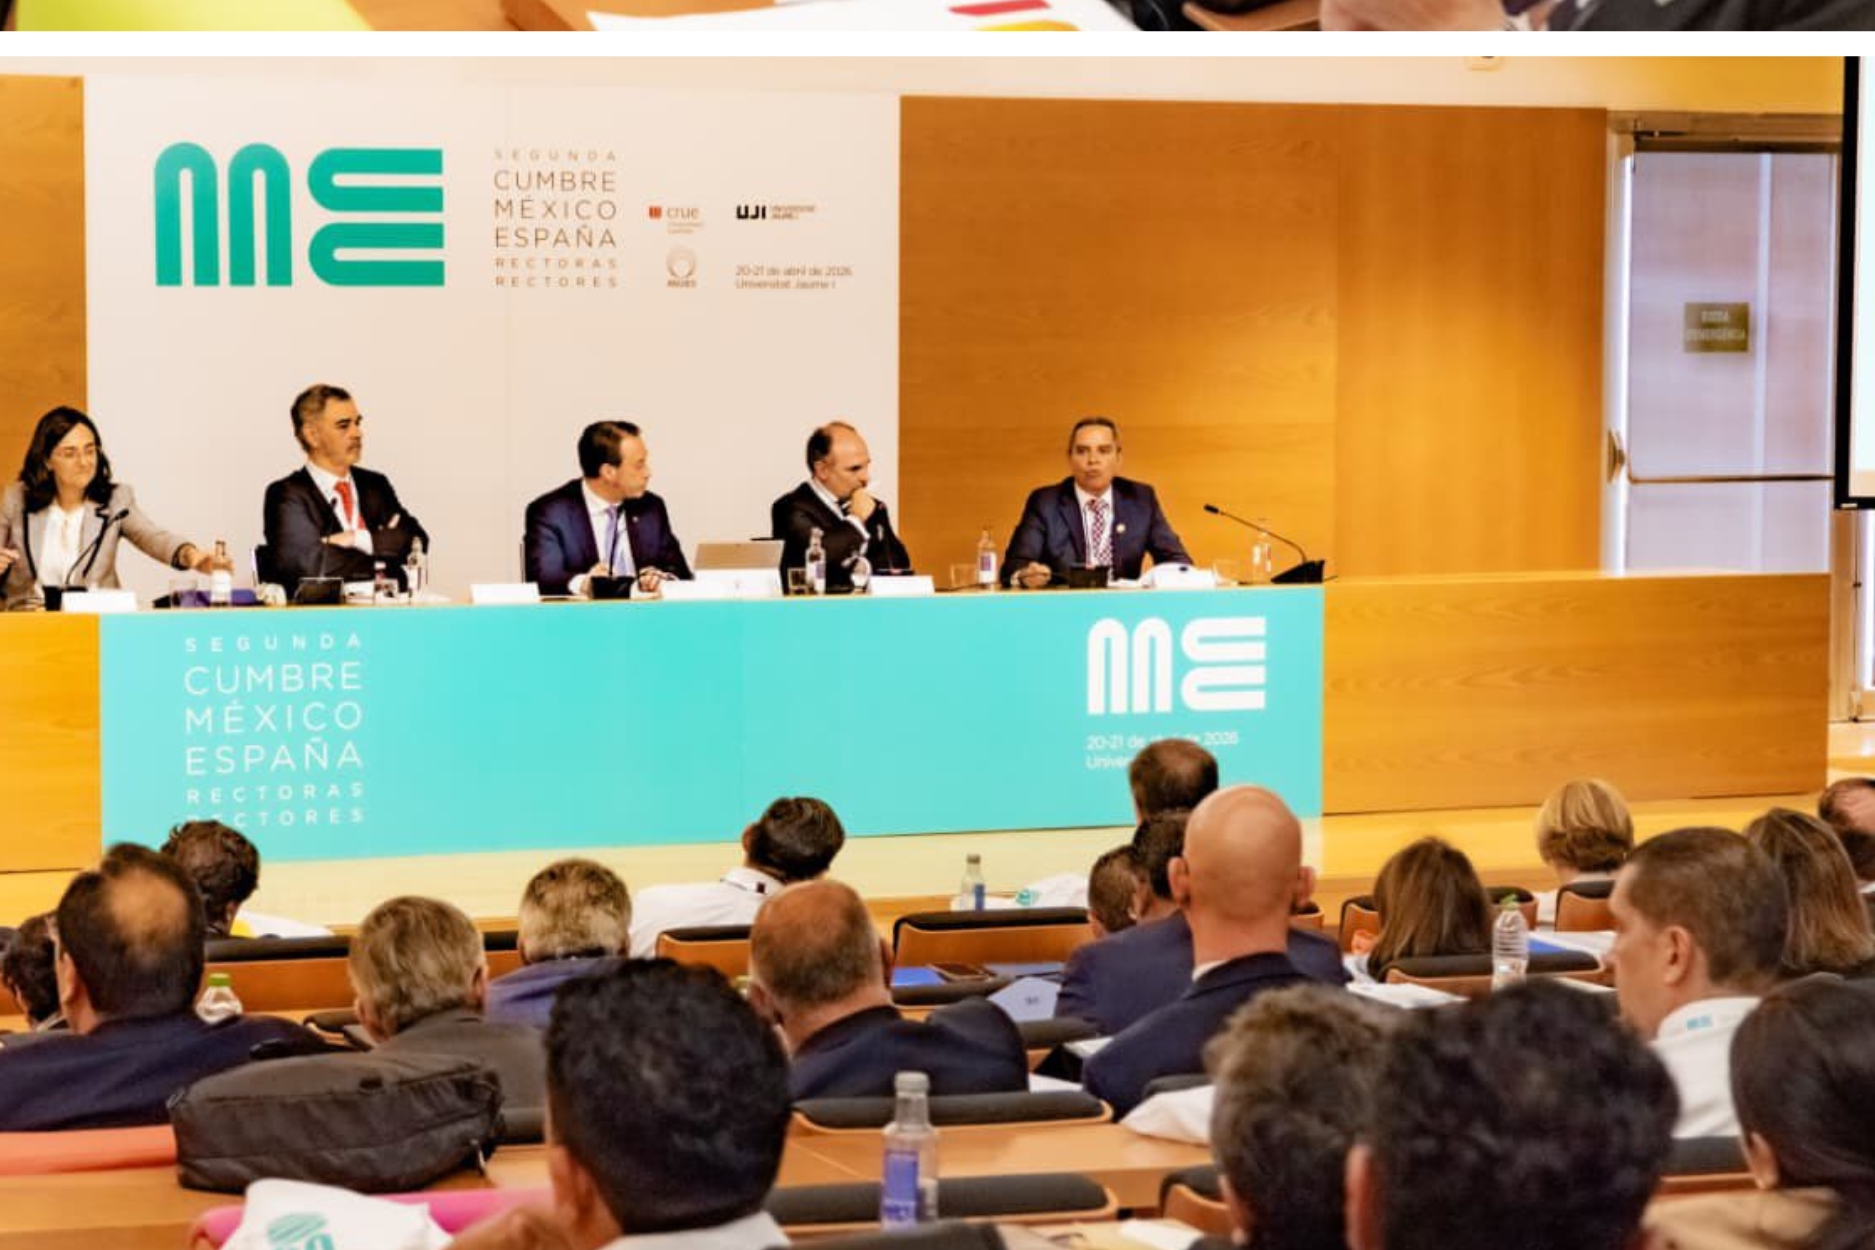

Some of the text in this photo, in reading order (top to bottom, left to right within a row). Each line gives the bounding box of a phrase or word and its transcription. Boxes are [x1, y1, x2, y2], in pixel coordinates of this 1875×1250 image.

[494, 149, 616, 162] SEGUNDA
[493, 169, 616, 192] CUMBRE
[494, 194, 617, 220] MÉXICO
[736, 205, 767, 220] UJI
[495, 224, 617, 249] ESPAÑA
[495, 257, 618, 270] RECTORAS
[495, 276, 618, 289] RECTORES
[184, 632, 362, 653] SEGUNDA
[183, 660, 364, 696] CUMBRE
[184, 698, 364, 735] MÉXICO
[185, 735, 364, 776] ESPAÑA
[186, 781, 365, 804] RECTORAS
